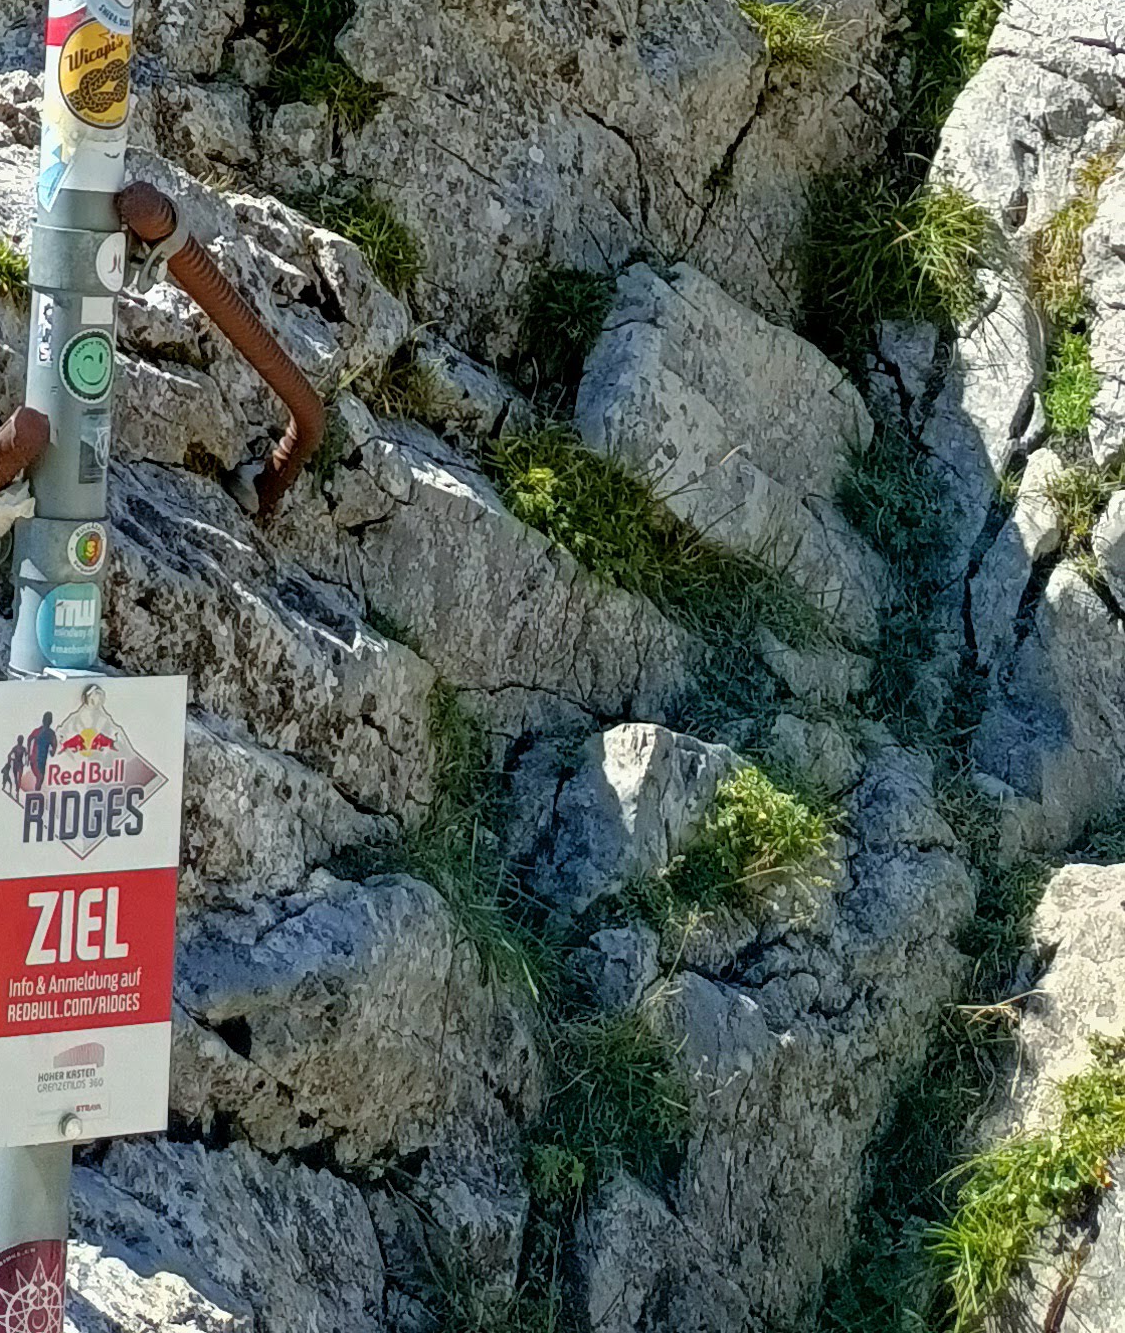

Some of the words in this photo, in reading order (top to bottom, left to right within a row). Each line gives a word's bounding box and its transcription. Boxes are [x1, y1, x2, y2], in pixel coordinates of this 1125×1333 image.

[47, 763, 85, 786] Red
[88, 760, 125, 784] Bull
[22, 787, 145, 844] RIDGES
[25, 886, 130, 966] ZIEL
[9, 976, 34, 998] Info
[36, 975, 46, 995] &
[48, 970, 119, 993] Anmeldung
[120, 966, 143, 988] auf
[7, 992, 141, 1023] REDBULL.COM/RIDGES
[38, 1071, 64, 1083] HOHER
[66, 1068, 96, 1080] KASTEN
